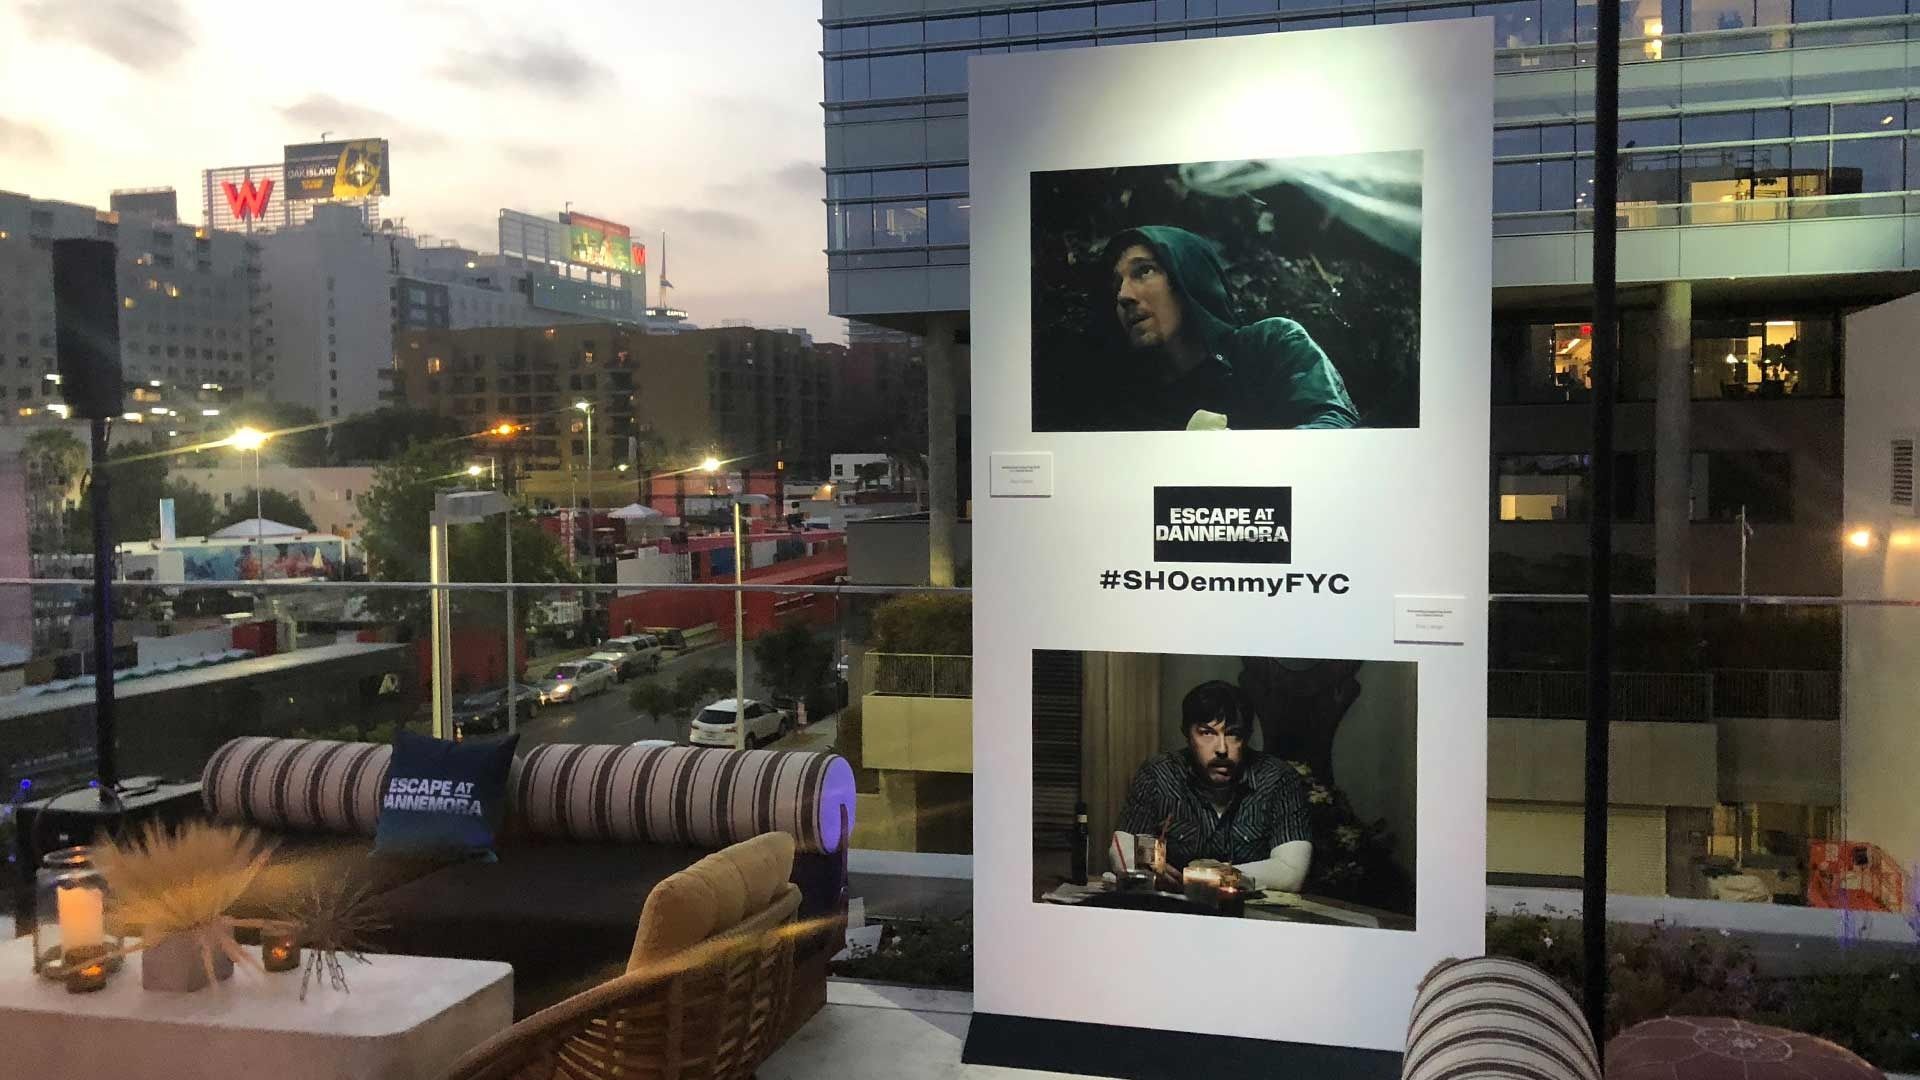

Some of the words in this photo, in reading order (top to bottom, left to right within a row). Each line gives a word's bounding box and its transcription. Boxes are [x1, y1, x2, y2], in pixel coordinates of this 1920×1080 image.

[305, 167, 337, 178] ISLAND
[221, 176, 275, 221] W
[633, 245, 646, 266] W
[1170, 507, 1251, 525] ESCAPE
[1254, 508, 1275, 524] AT
[1155, 525, 1290, 543] DANNEMORA
[1099, 569, 1350, 597] #SHOemmyFYC
[389, 777, 452, 796] ESCAPE
[454, 782, 475, 798] AT
[384, 794, 482, 816] ANNEMORA
